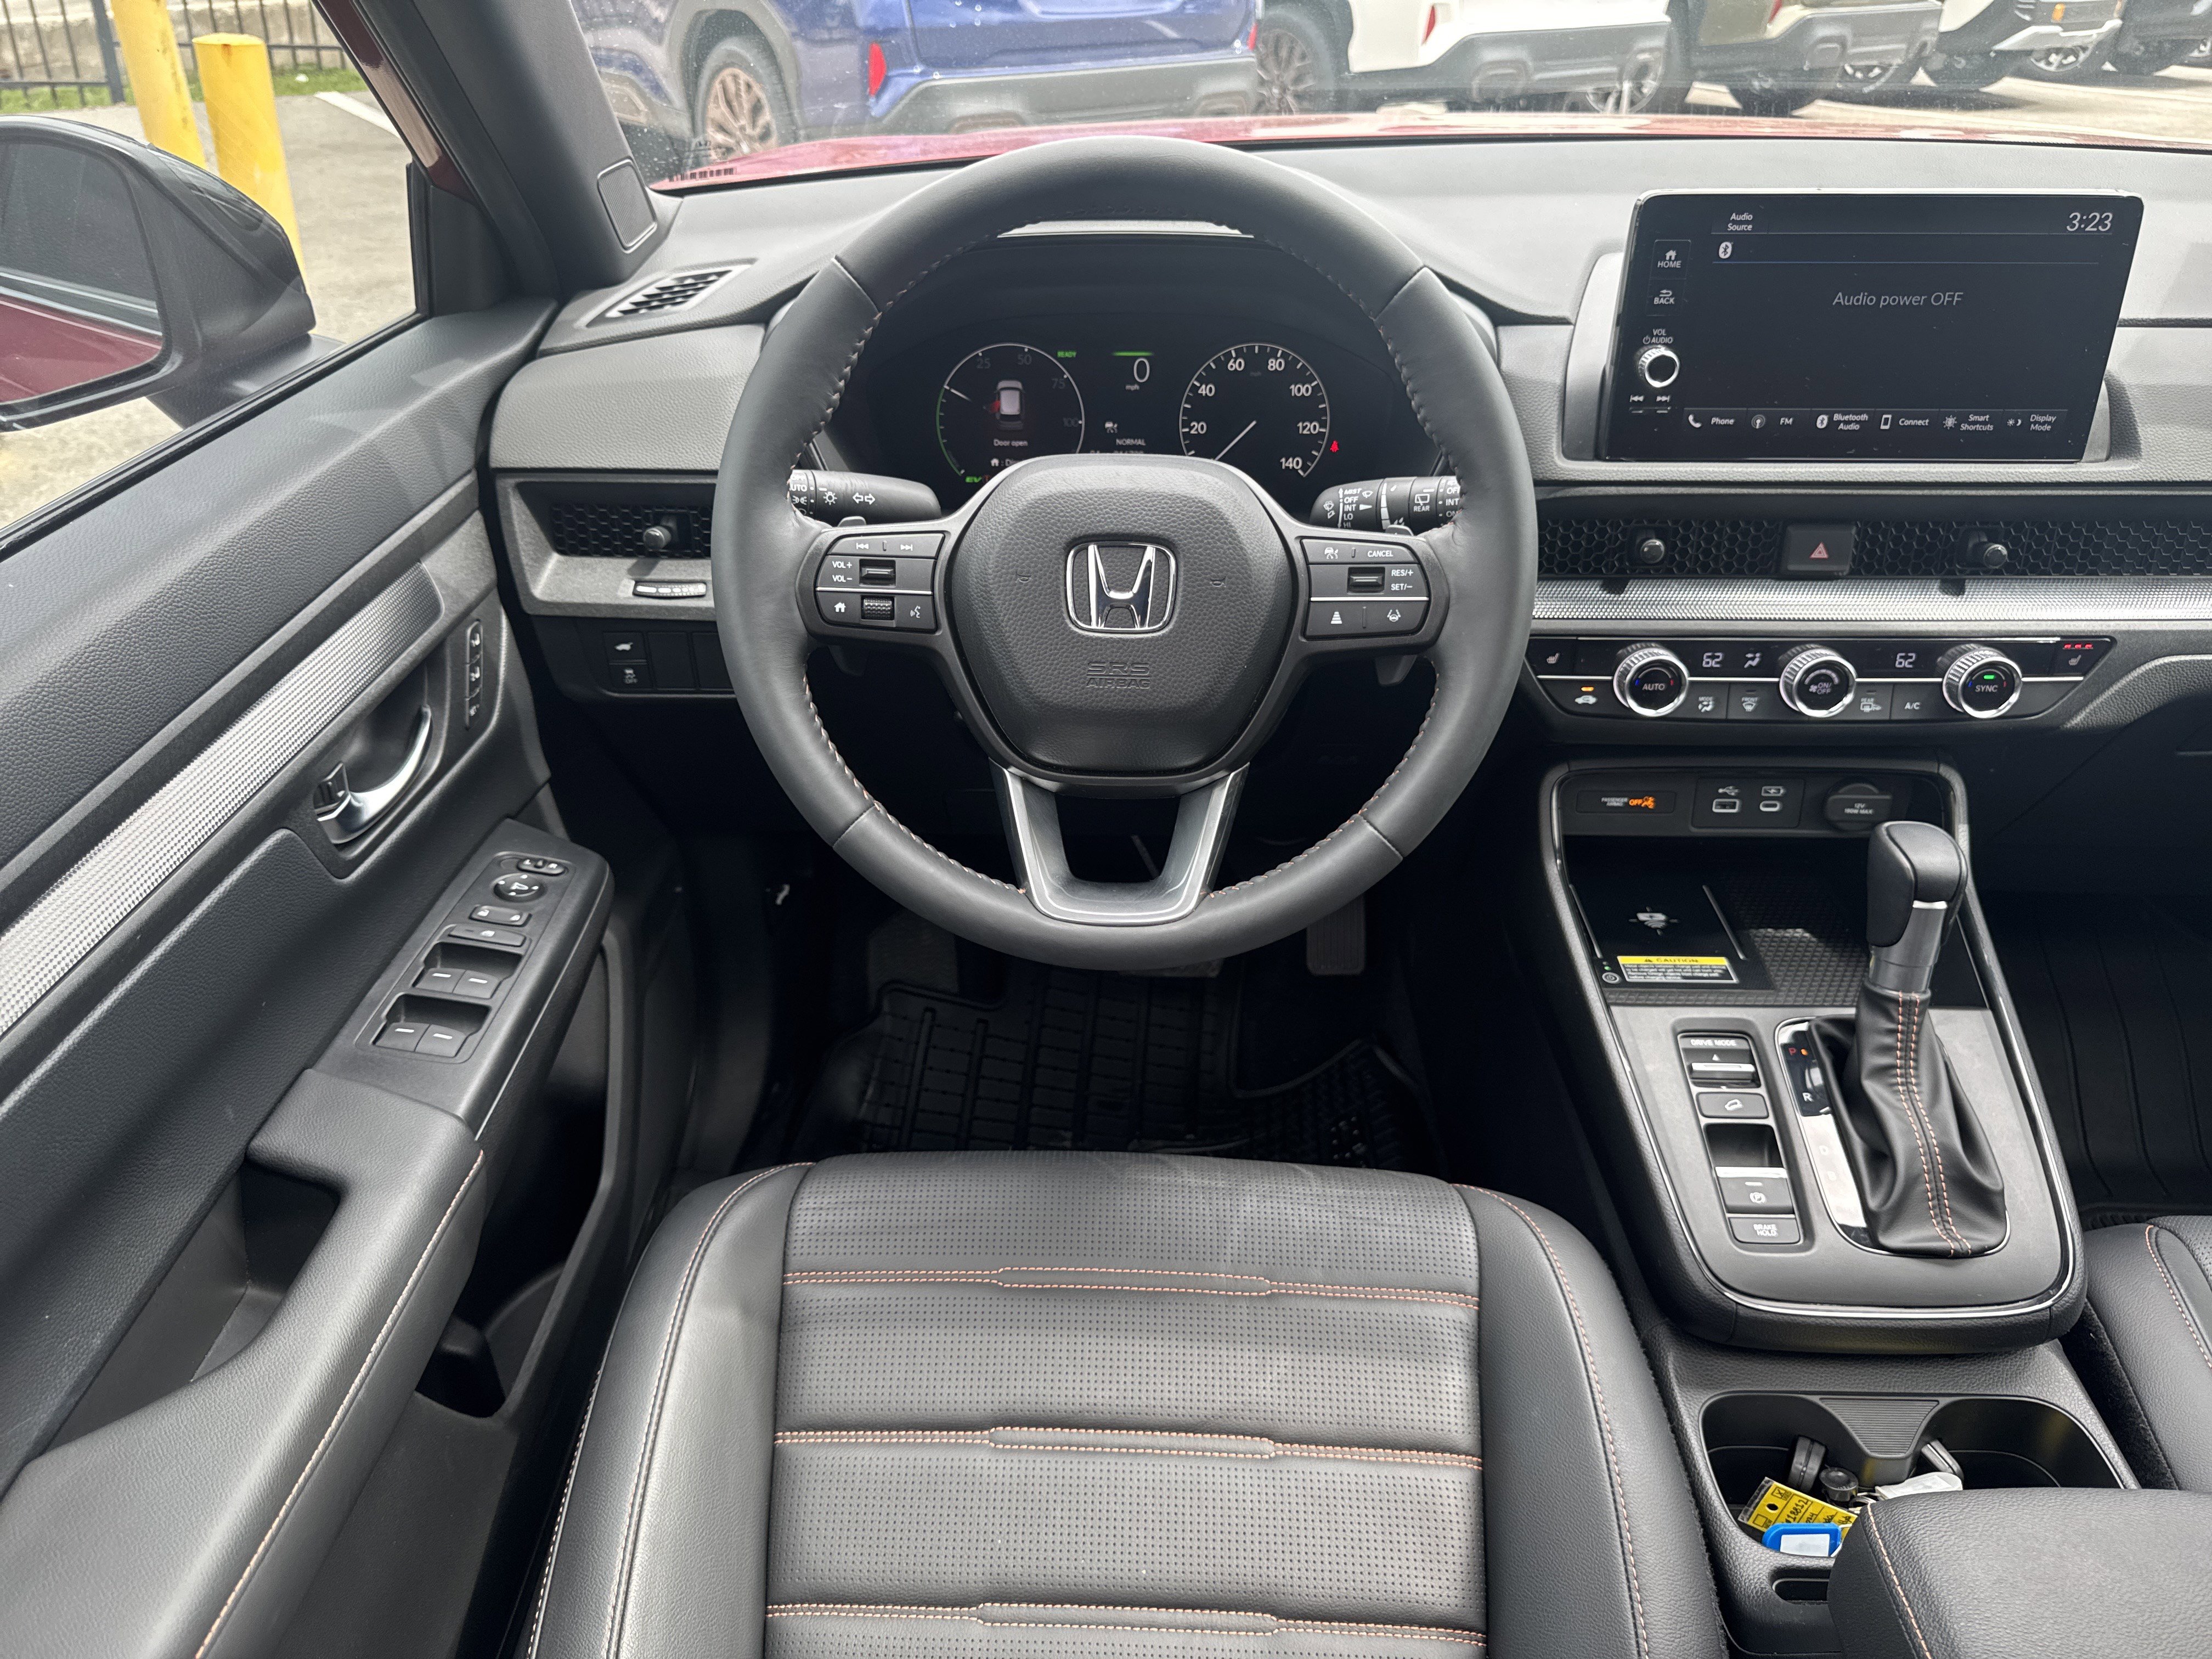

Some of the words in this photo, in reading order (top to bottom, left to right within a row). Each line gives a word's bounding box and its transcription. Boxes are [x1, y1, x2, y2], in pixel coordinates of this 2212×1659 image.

[1730, 212, 1753, 221] Audio
[2066, 212, 2113, 232] 3:23
[1727, 223, 1752, 231] Source
[1832, 292, 1876, 306] Audio
[1880, 294, 1927, 308] power
[1931, 292, 1963, 306] OFF
[1227, 357, 1245, 371] 60
[1267, 358, 1285, 371] 80
[1133, 358, 1150, 382] 0
[1198, 383, 1216, 397] 40
[1289, 383, 1312, 397] 100
[1711, 417, 1734, 426] Phone
[1780, 417, 1793, 426] FM
[1833, 413, 1869, 422] Bluetooth
[1899, 418, 1929, 426] Connect
[1968, 414, 1990, 422] Smart
[2030, 414, 2057, 424] Display
[1190, 421, 1207, 434] 20
[1297, 421, 1319, 434] 120
[1838, 422, 1860, 431] Audio
[1960, 423, 1994, 431] Shortcuts
[2030, 424, 2052, 432] Mode
[1280, 457, 1303, 470] 140
[789, 484, 808, 492] UTO
[1702, 652, 1723, 668] 62
[1895, 652, 1916, 668] 62
[1086, 662, 1150, 675] SRS
[1086, 678, 1151, 690] AIRBAG
[1788, 1047, 1797, 1056] P
[1802, 1092, 1813, 1102] R
